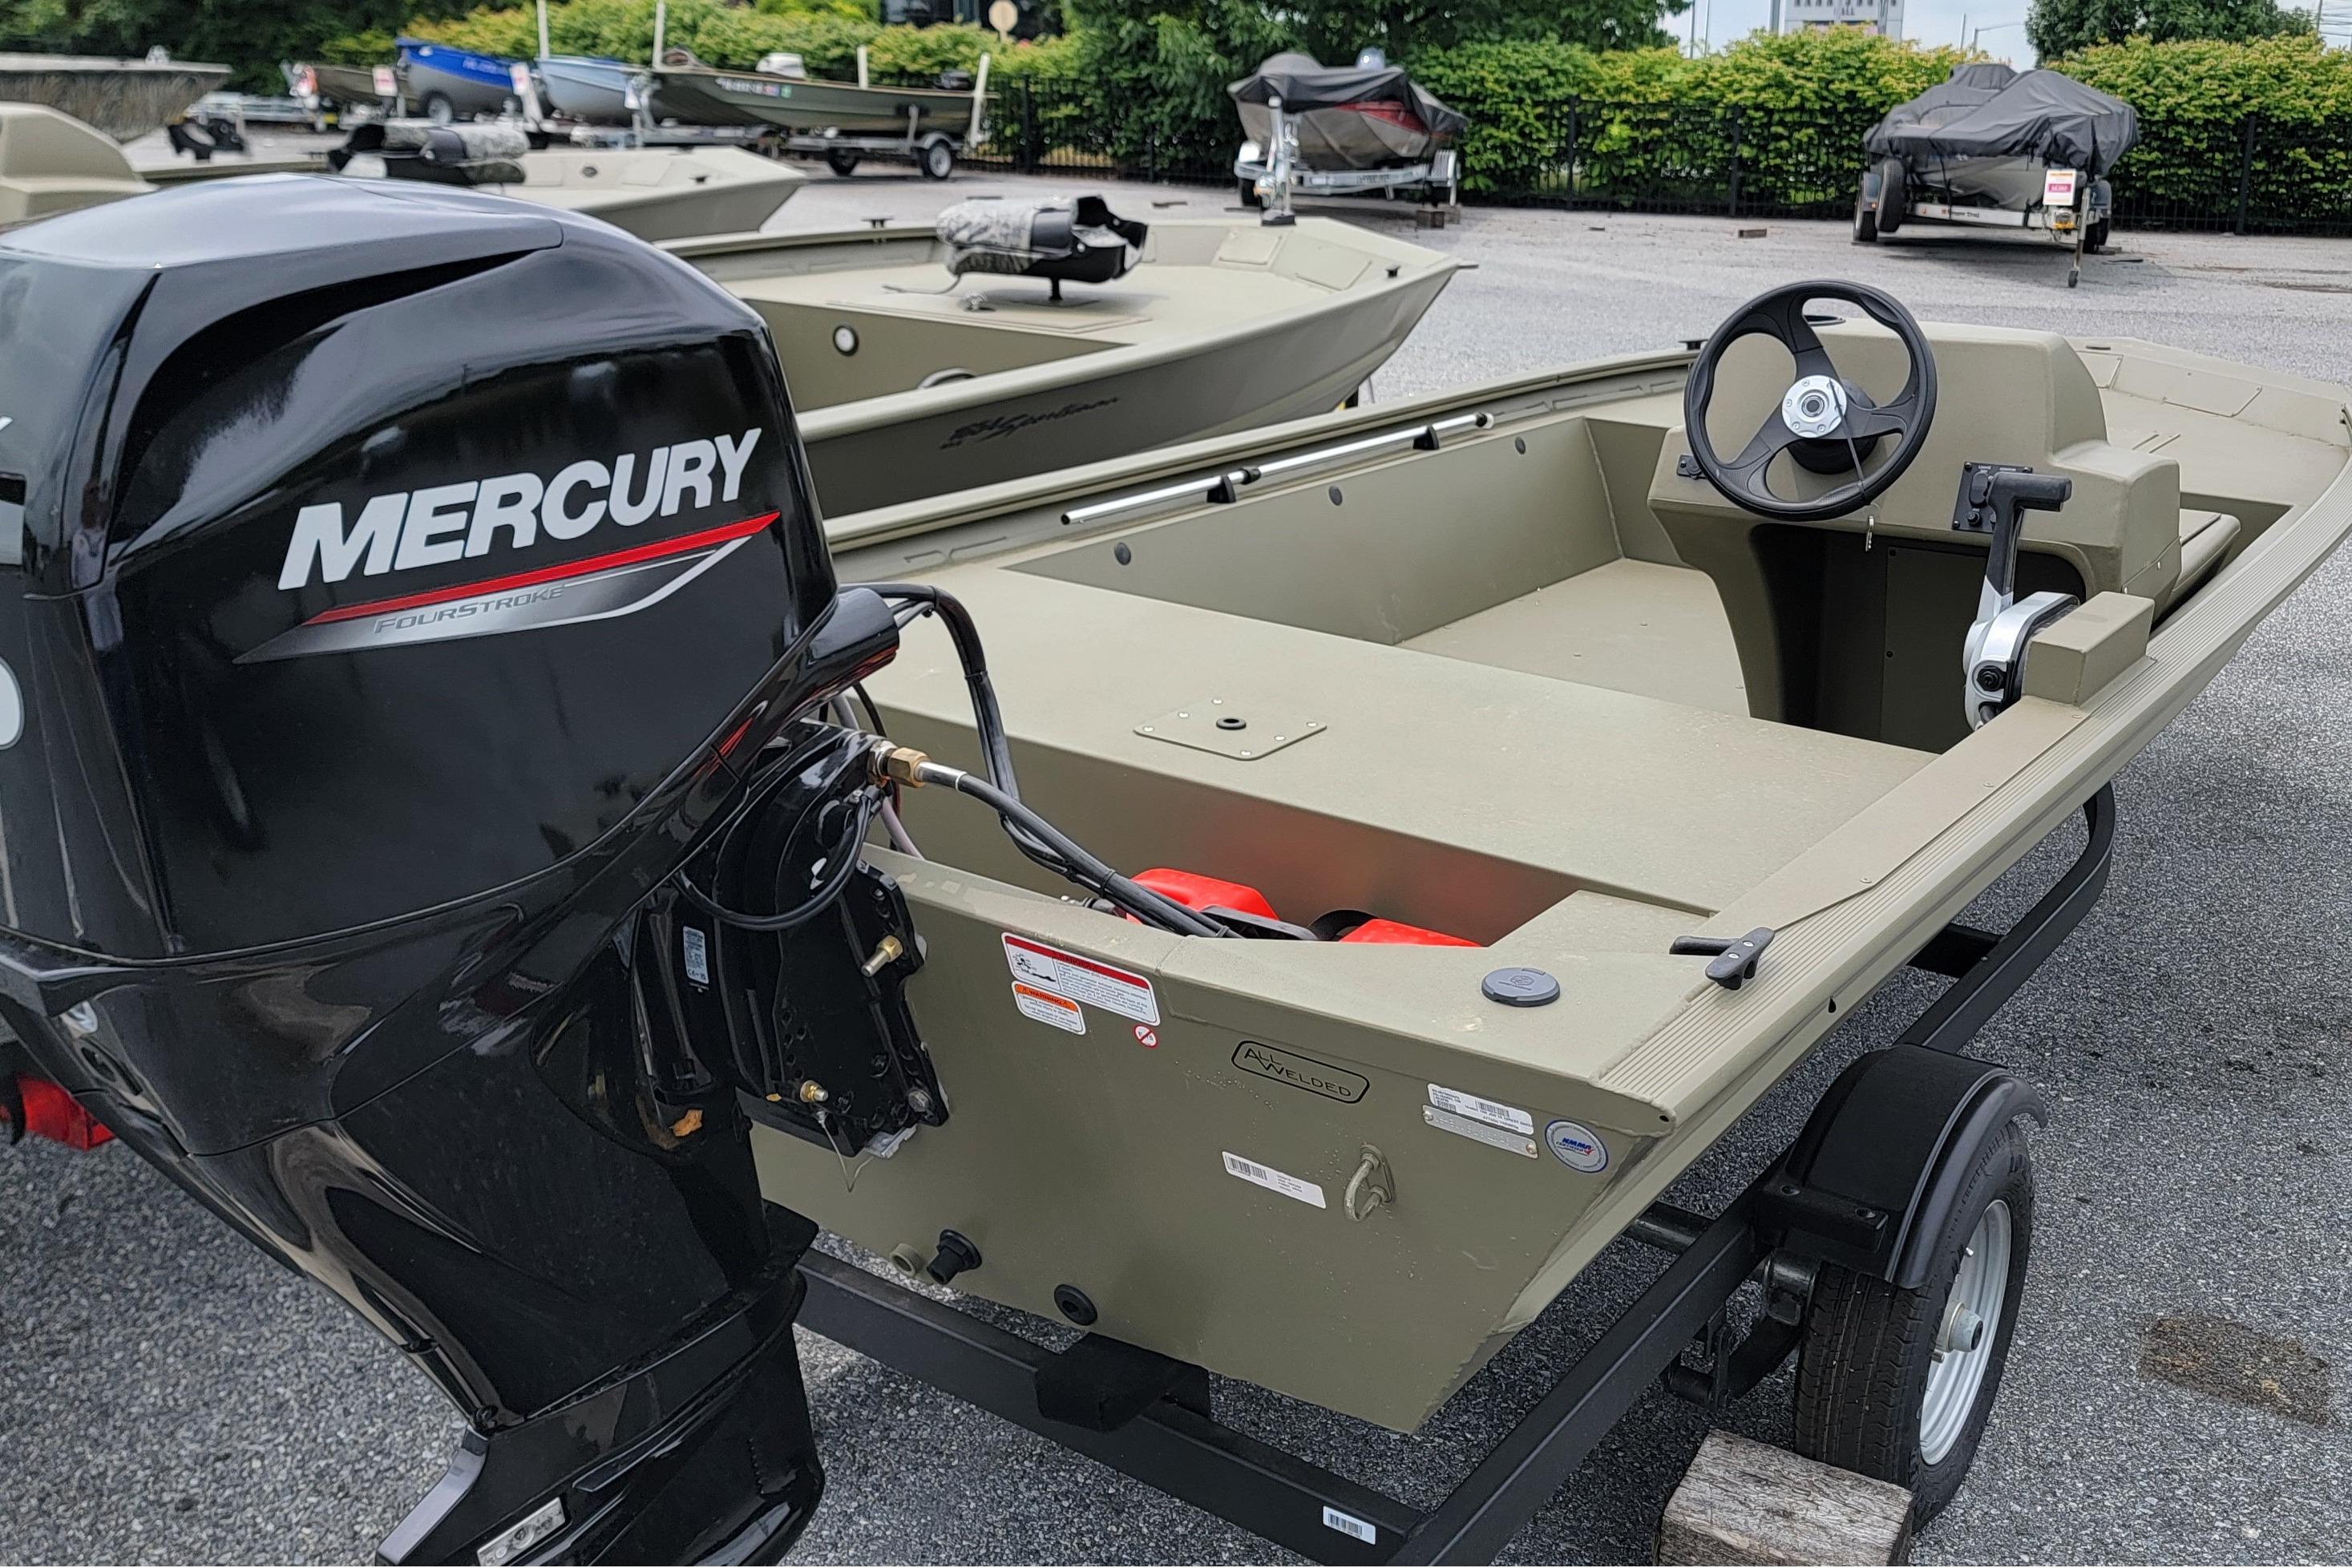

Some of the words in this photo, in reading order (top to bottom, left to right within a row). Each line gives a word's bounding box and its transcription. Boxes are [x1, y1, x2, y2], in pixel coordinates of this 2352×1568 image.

[277, 427, 762, 591] MERCURY
[374, 584, 564, 633] FOURSTROKE
[1244, 1048, 1282, 1066] ALL
[1258, 1058, 1352, 1097] WELDED
